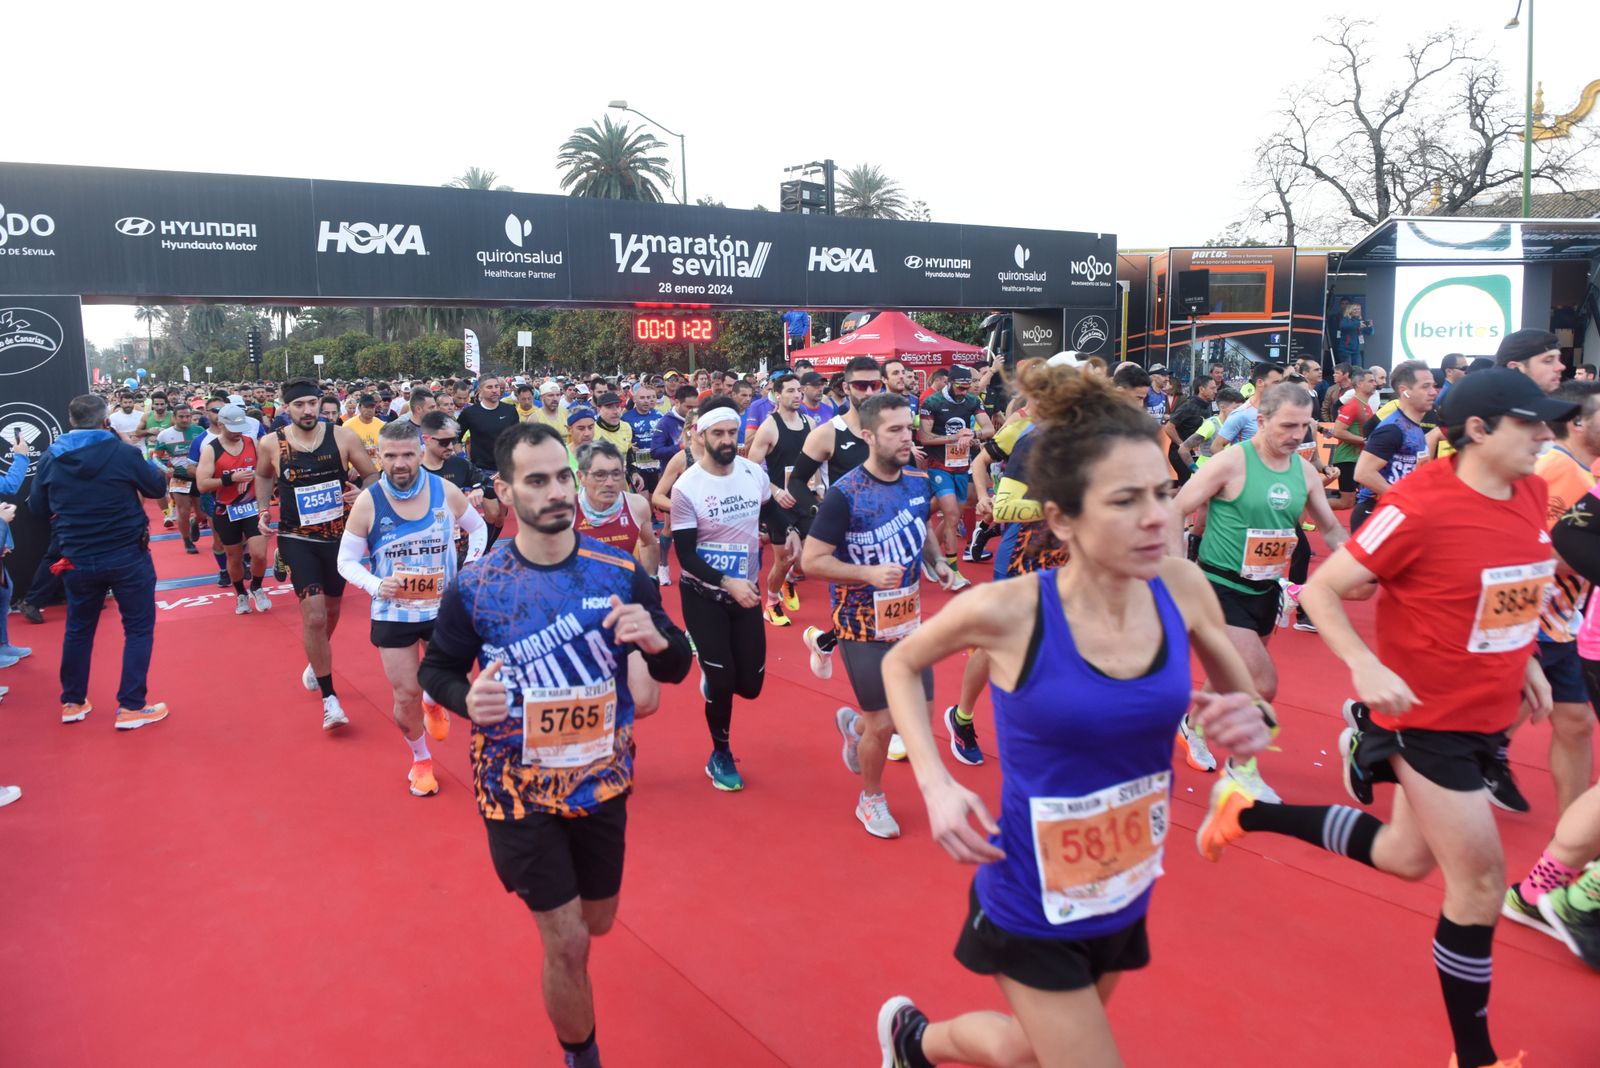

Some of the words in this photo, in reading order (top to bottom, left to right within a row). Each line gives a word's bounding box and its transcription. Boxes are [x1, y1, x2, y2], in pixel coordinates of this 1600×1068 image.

[160, 220, 256, 237] HYUNDAI
[162, 240, 224, 252] Hyundauto
[226, 242, 258, 251] Motor
[317, 221, 427, 256] HOKA
[642, 233, 749, 258] maratón
[672, 256, 751, 278] sevilla
[808, 246, 875, 272] HOKA
[925, 258, 971, 270] HYUNDAI
[484, 269, 526, 278] Healthcare
[528, 270, 556, 278] Partner
[925, 270, 953, 278] Hyundauto
[658, 282, 672, 294] 28
[674, 286, 705, 294] enero
[708, 284, 733, 294] 2024
[637, 320, 712, 340] 00:01:22
[14, 335, 44, 345] Canarias
[232, 502, 252, 515] 1610
[303, 492, 332, 508] 2554
[720, 494, 744, 506] MEDIA
[722, 498, 759, 515] MARATÓN
[708, 507, 718, 518] 37
[874, 508, 914, 542] MARATÓN
[1254, 542, 1286, 557] 4521
[704, 553, 736, 570] 2297
[884, 599, 914, 618] 4216
[540, 704, 600, 734] 5765
[1061, 811, 1142, 864] 5816
